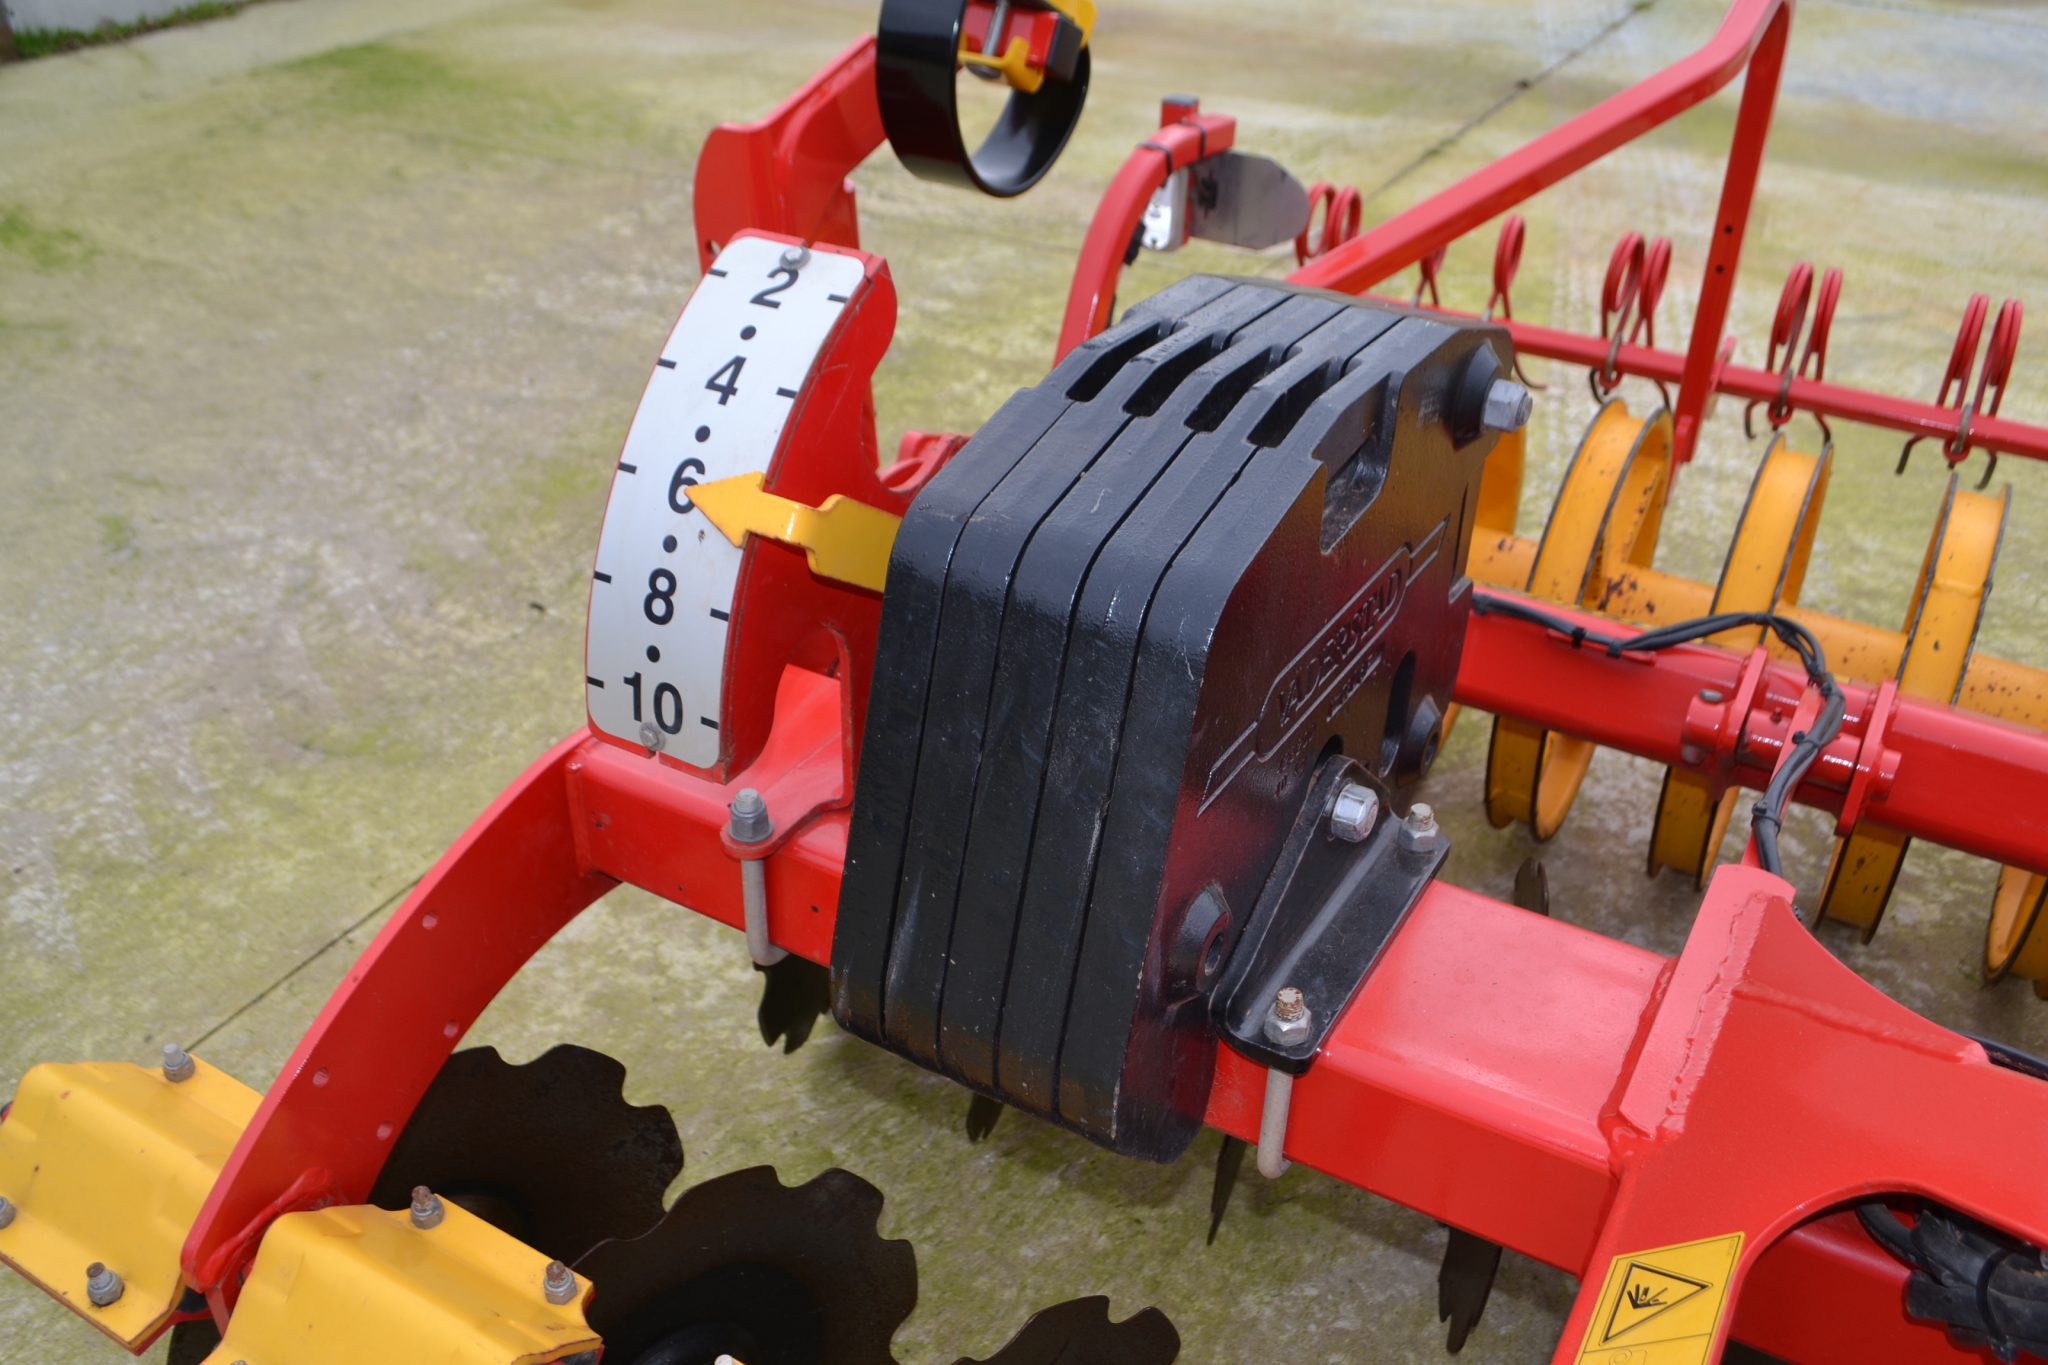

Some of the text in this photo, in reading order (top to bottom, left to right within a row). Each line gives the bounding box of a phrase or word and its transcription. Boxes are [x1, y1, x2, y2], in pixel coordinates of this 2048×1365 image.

[750, 267, 799, 308] 2
[705, 356, 746, 406] 4
[668, 458, 705, 514] 6
[644, 568, 677, 625] 8
[623, 672, 683, 735] 10
